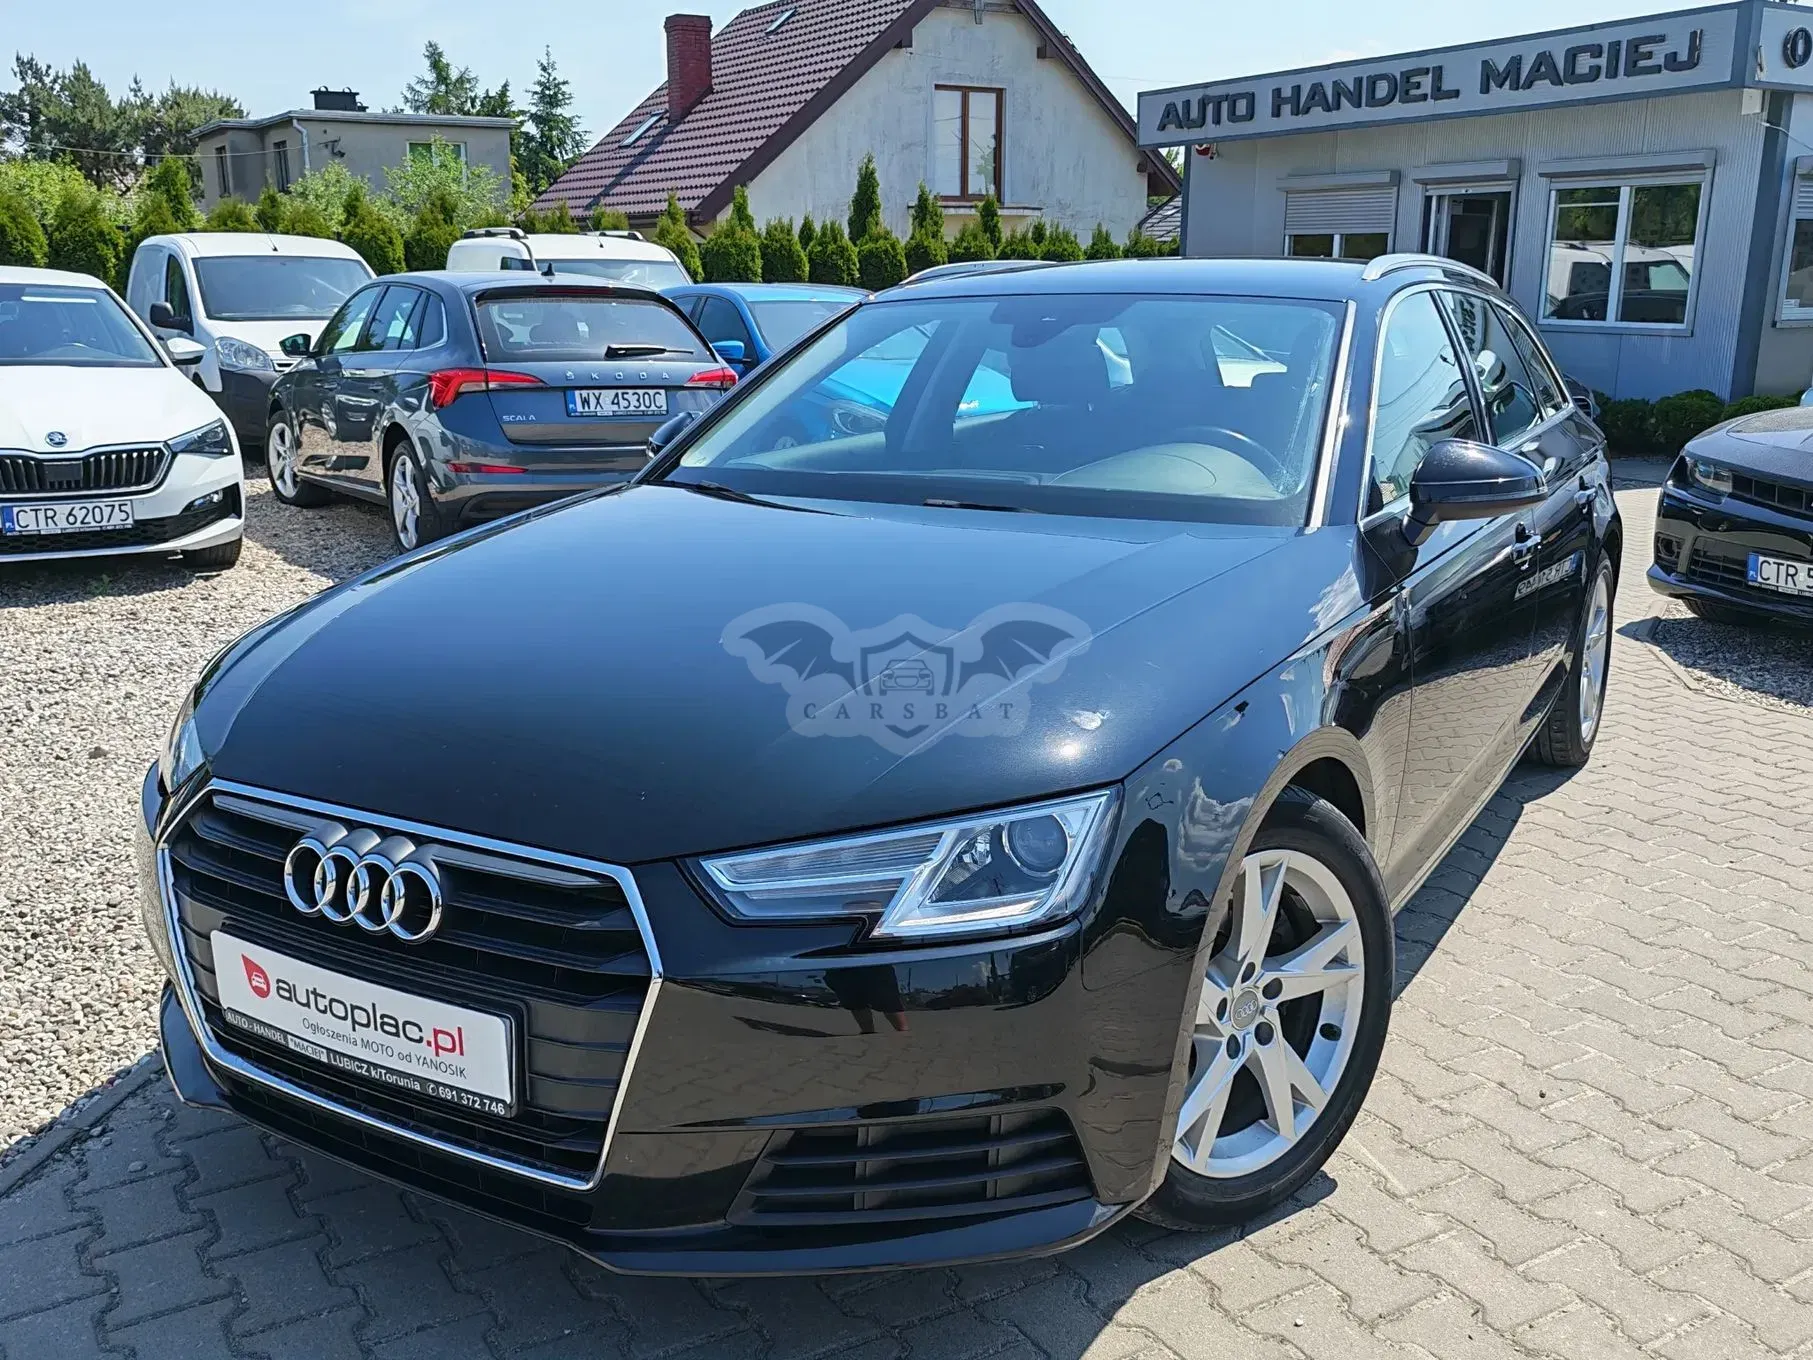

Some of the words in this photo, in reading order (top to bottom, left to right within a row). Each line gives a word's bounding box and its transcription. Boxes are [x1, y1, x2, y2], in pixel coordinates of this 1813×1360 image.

[1157, 91, 1255, 132] AUTO
[1271, 65, 1461, 118] HANDEL
[1479, 29, 1704, 95] MACIEJ
[502, 414, 537, 422] SCALA
[579, 391, 604, 410] WX
[611, 391, 664, 410] 4530C
[16, 507, 58, 529] CTR
[66, 503, 130, 526] 62075
[1760, 560, 1798, 588] CTR
[276, 978, 465, 1057] autoplac.pl
[226, 1012, 248, 1029] AUTO
[330, 1052, 370, 1076] LUBICZ
[370, 1066, 421, 1092] k/Torunia
[438, 1086, 458, 1102] 691
[460, 1093, 482, 1109] 372
[483, 1099, 506, 1115] 746
[302, 1017, 358, 1047] Ogłoszenia
[360, 1038, 394, 1058] MOTO
[398, 1050, 412, 1064] od
[415, 1055, 467, 1080] YANOSIK
